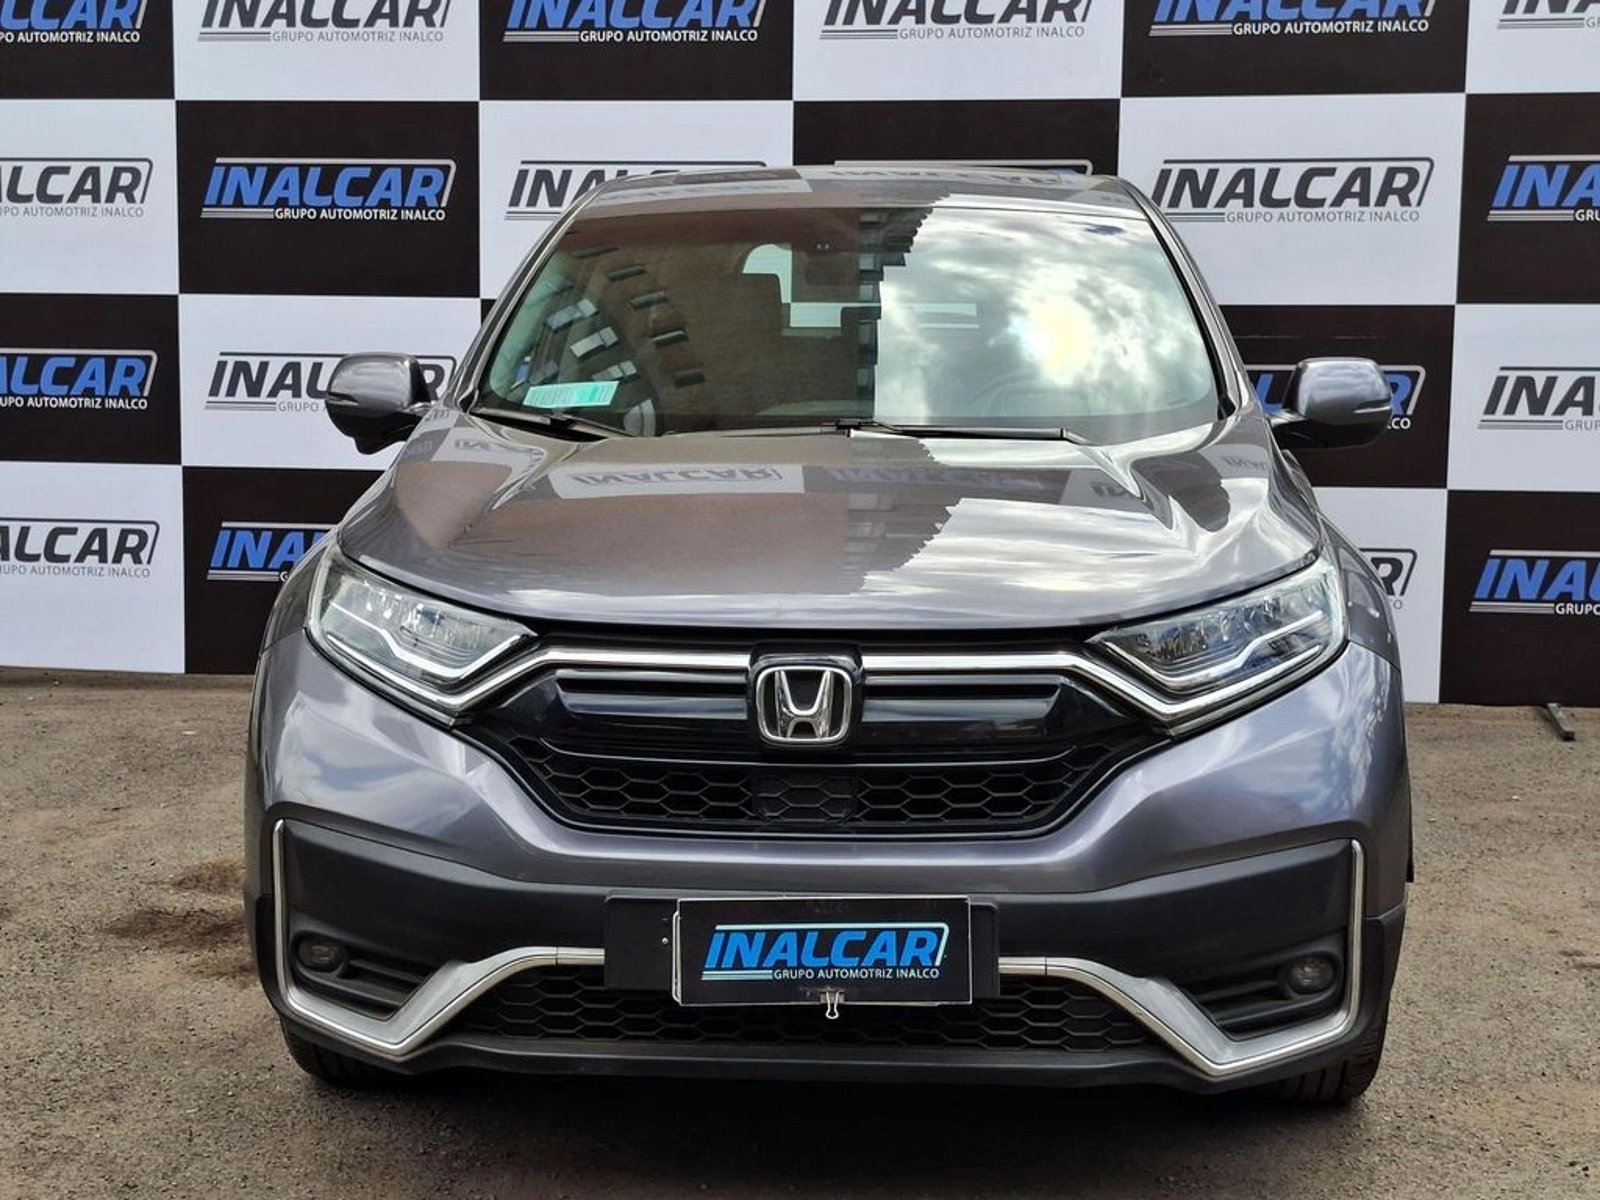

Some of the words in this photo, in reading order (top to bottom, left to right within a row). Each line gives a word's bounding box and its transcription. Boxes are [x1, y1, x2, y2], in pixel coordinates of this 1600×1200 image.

[900, 28, 944, 39] GRUPO
[948, 27, 1032, 38] AUTOMOTRIZ
[1036, 26, 1084, 37] INALCO
[1233, 23, 1280, 36] GRUPO
[1284, 21, 1373, 34] AUTOMOTRIZ
[1377, 19, 1429, 32] INALCO
[17, 31, 94, 42] AUTOMOTRIZ
[97, 31, 140, 42] INALCO
[272, 31, 313, 41] GRUPO
[317, 31, 395, 41] AUTOMOTRIZ
[400, 31, 443, 41] INALCO
[580, 30, 623, 42] GRUPO
[627, 30, 708, 41] AUTOMOTRIZ
[712, 29, 758, 41] INALCO
[0, 166, 142, 203] LCAR
[204, 166, 445, 206] INALCAR
[1151, 167, 1420, 208] INALCAR
[23, 206, 98, 217] AUTOMOTRIZ
[101, 207, 144, 217] INALCO
[275, 208, 317, 219] GRUPO
[320, 209, 397, 220] AUTOMOTRIZ
[401, 209, 446, 221] INALCO
[1226, 211, 1273, 223] GRUPO
[1277, 210, 1365, 222] AUTOMOTRIZ
[1369, 210, 1420, 222] INALCO
[0, 356, 146, 396] LCAR
[208, 360, 445, 401] INALR
[27, 397, 102, 408] AUTOMOTRIZ
[105, 398, 148, 409] INALCO
[278, 402, 320, 412] GRUPO
[0, 526, 149, 565] LCAR
[30, 566, 104, 577] AUTOMOTRIZ
[108, 567, 150, 578] INALCO
[705, 930, 938, 968] INALCAR
[773, 969, 815, 980] GRUPO
[818, 968, 893, 979] AUTOMOTRIZ
[896, 968, 940, 979] INALCO
